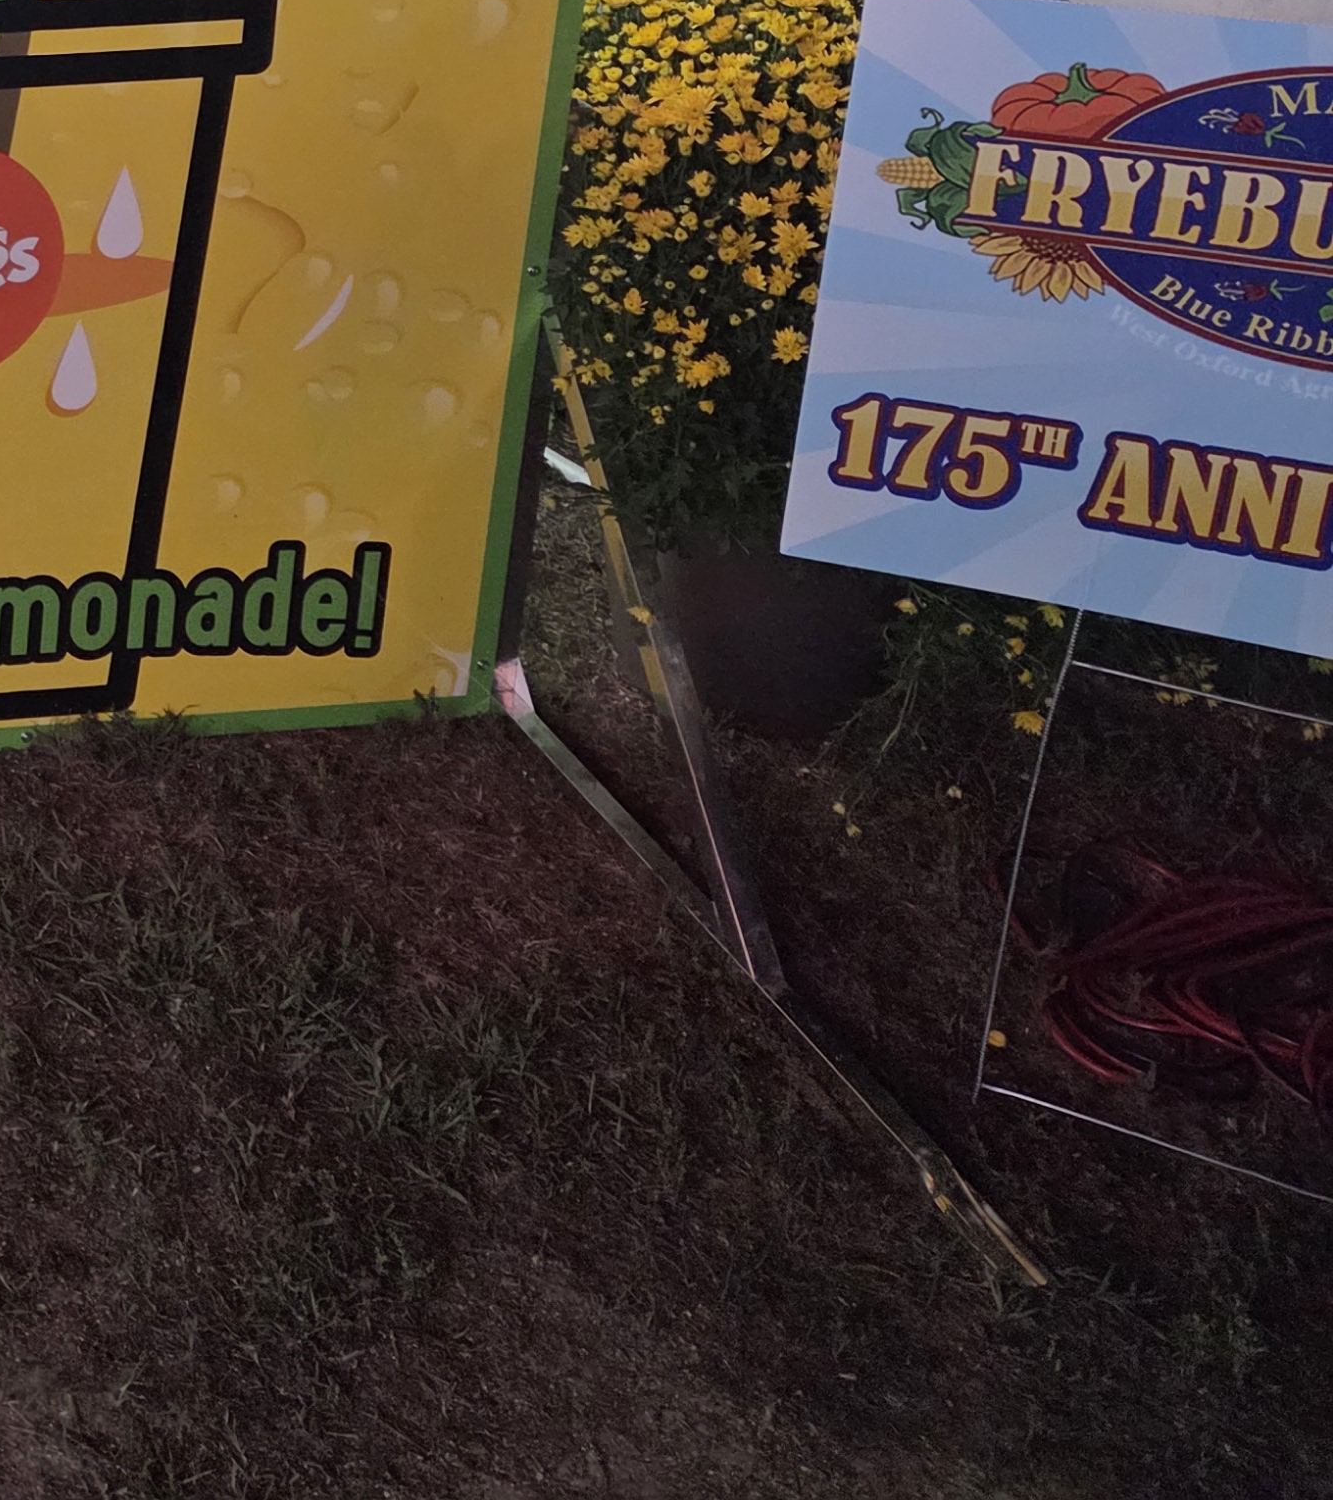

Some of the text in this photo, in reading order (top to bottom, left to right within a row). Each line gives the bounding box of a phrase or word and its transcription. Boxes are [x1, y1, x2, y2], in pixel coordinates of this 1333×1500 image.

[1268, 81, 1333, 117] M
[966, 141, 1333, 260] FRYEBU
[1149, 273, 1333, 356] Blue Ribb
[1175, 341, 1275, 387] Oxford
[1081, 434, 1333, 564] ANNI
